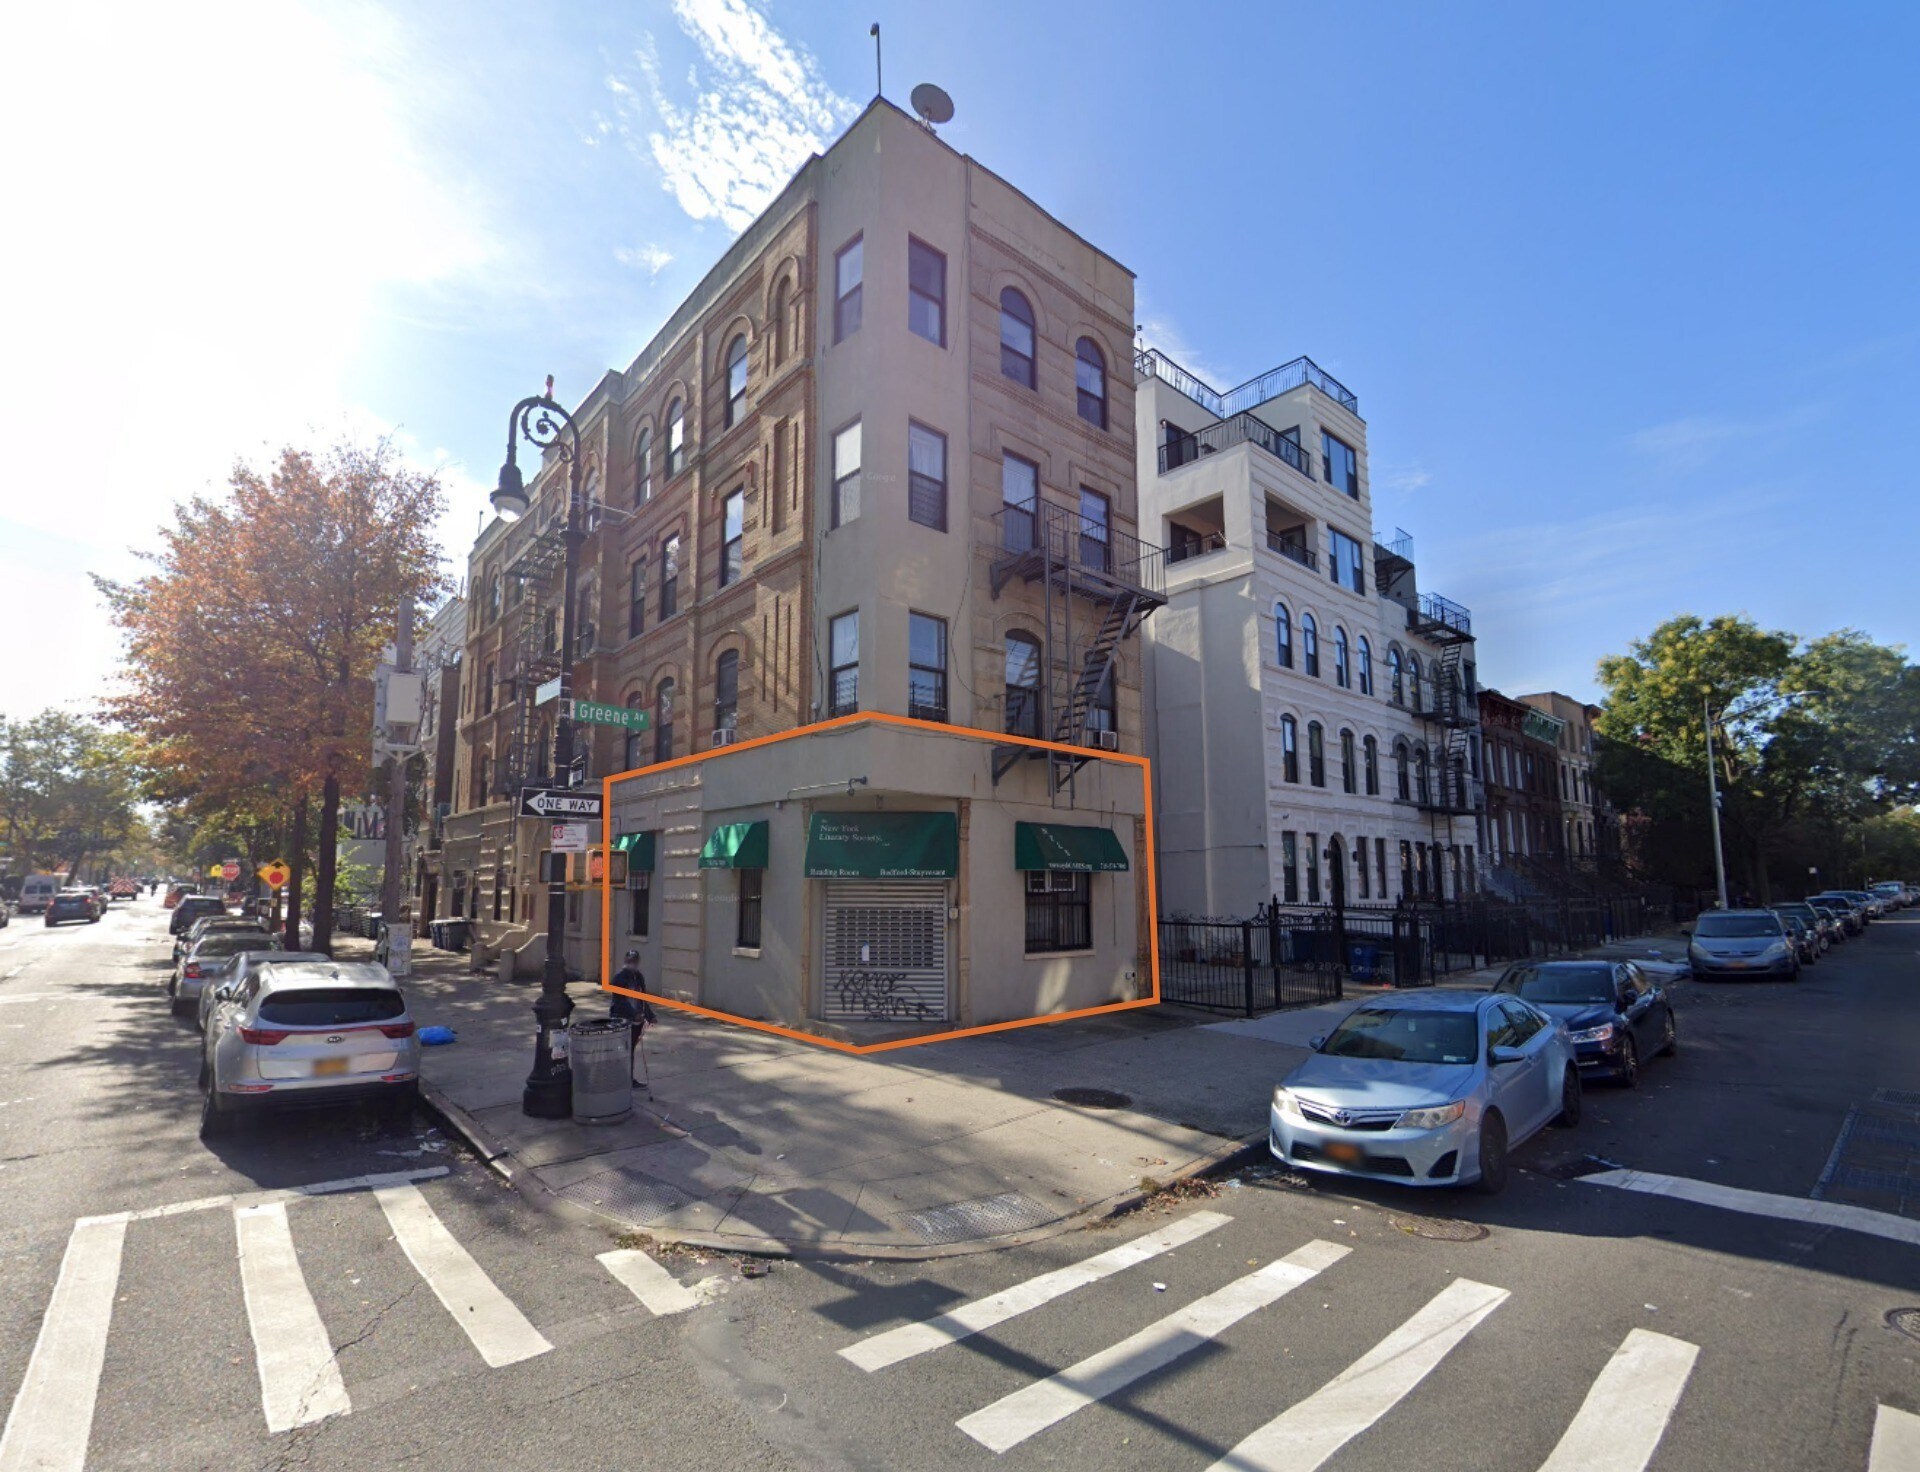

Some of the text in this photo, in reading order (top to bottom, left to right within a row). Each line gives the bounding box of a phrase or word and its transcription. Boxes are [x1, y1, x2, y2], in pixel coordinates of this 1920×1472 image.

[580, 703, 629, 726] Greene
[537, 798, 594, 811] ONE WAY
[820, 824, 860, 833] New York
[810, 868, 838, 877] Reading
